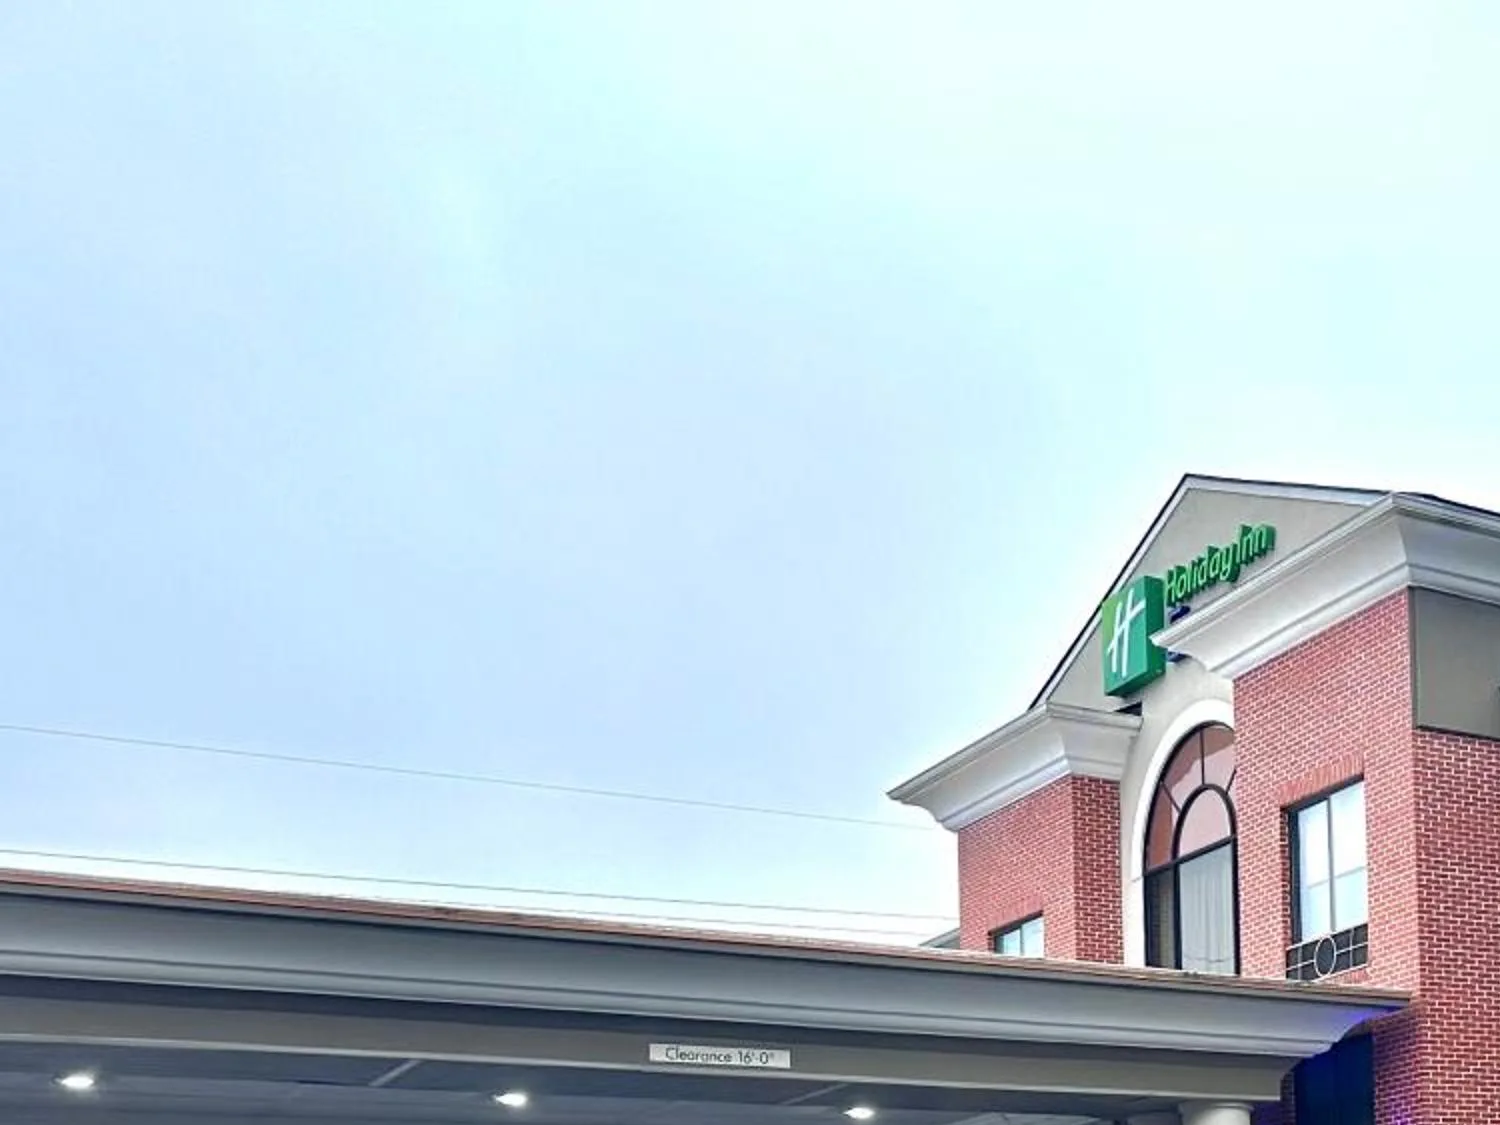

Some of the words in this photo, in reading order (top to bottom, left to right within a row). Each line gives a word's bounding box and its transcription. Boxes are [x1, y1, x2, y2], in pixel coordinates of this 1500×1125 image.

[1164, 545, 1238, 605] Holiday
[1234, 522, 1275, 564] Inn
[665, 1047, 732, 1063] Clearance
